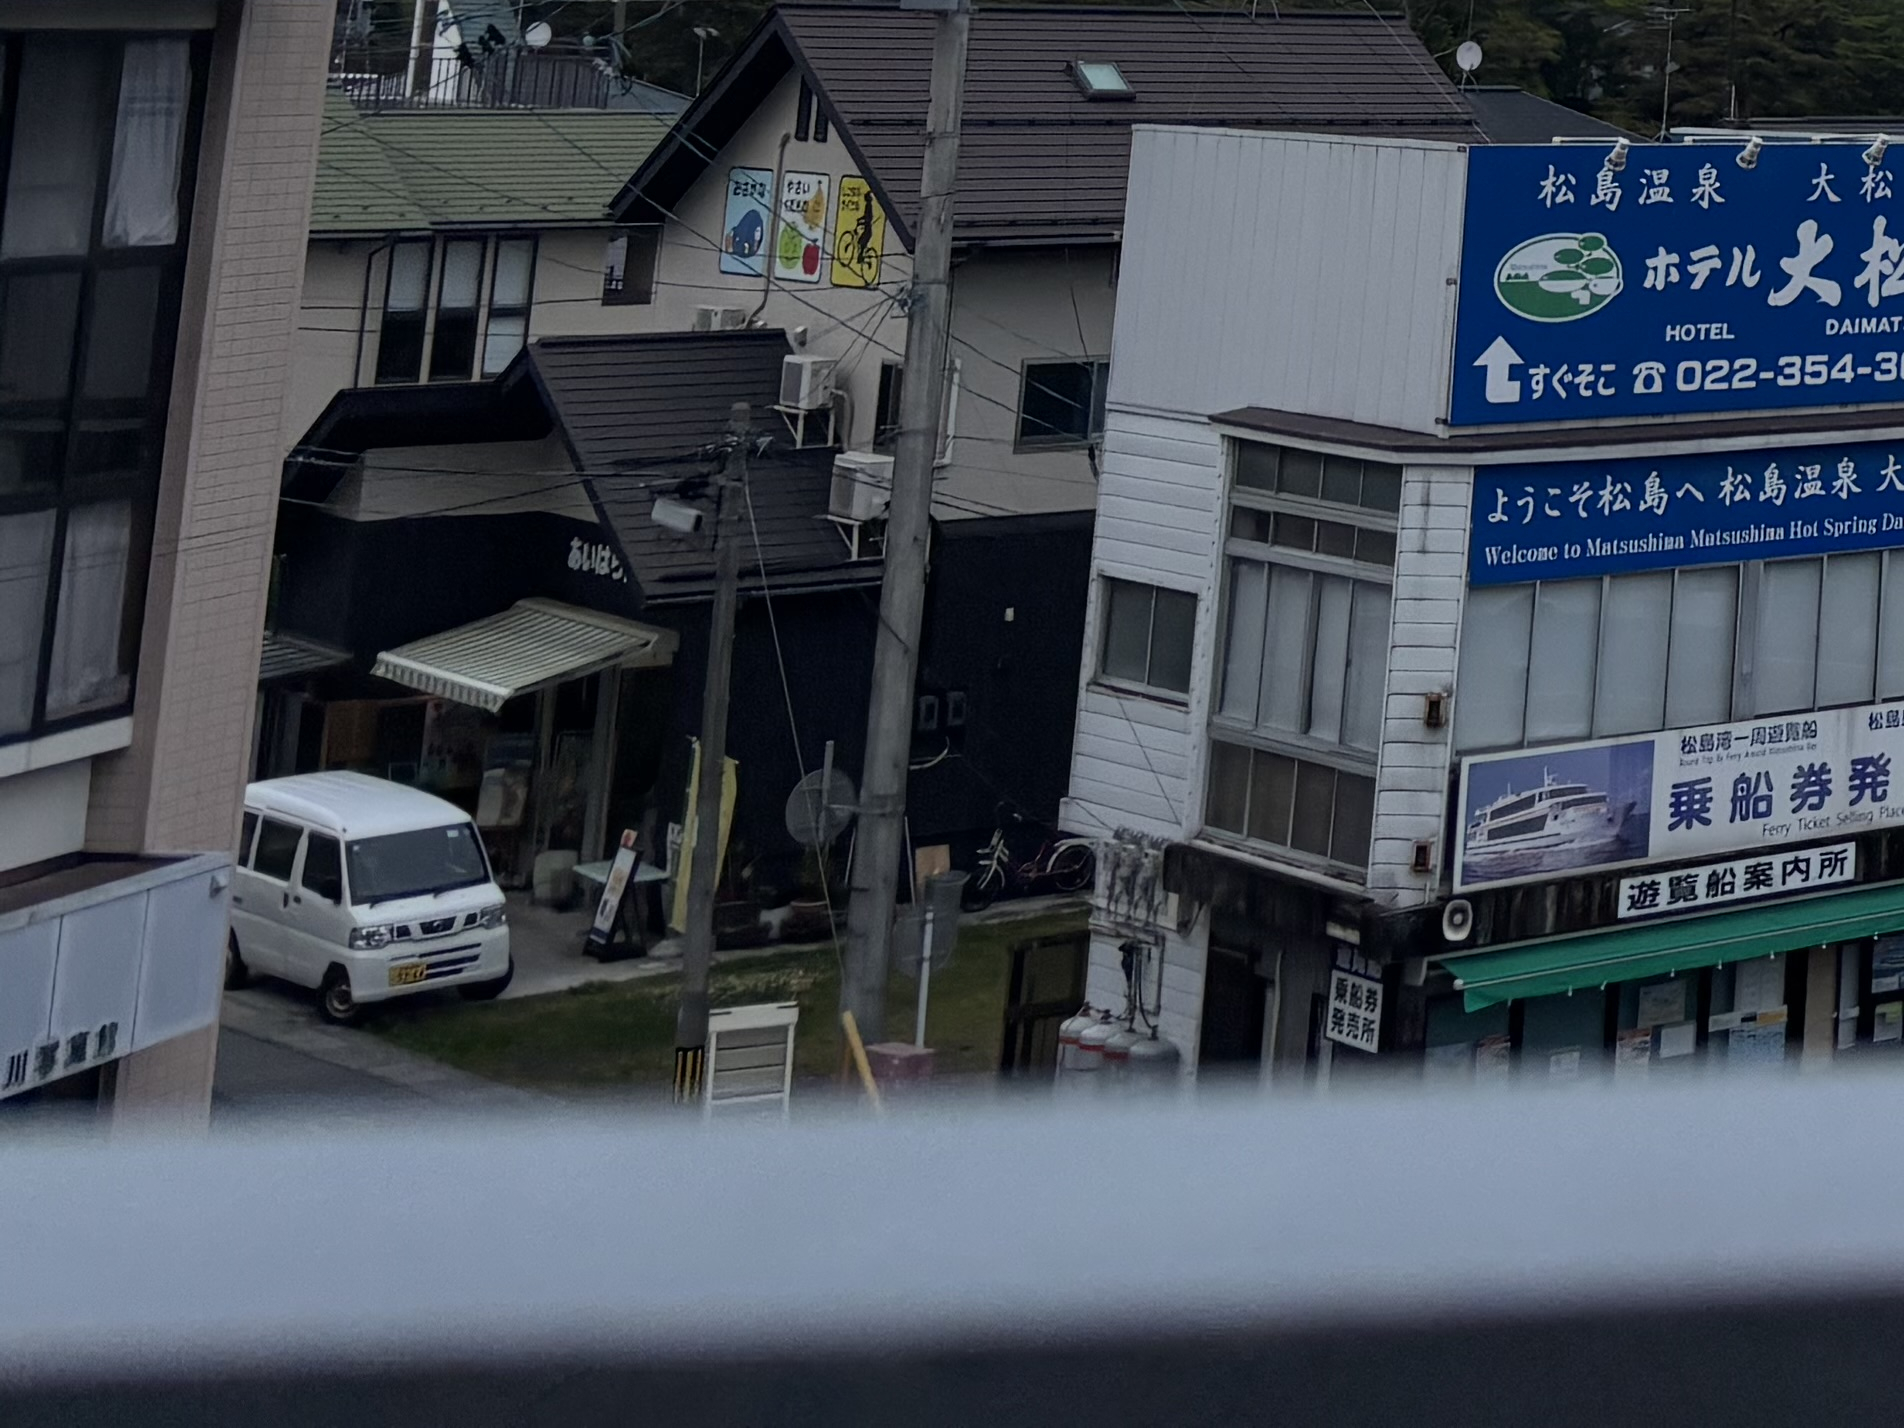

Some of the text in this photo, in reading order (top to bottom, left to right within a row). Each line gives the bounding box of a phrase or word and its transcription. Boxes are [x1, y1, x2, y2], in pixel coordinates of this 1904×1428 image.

[1538, 163, 1725, 211] 松島温泉
[1665, 323, 1735, 341] HOTEL
[1528, 362, 1616, 401] すぐそこ
[1487, 470, 1705, 525] ようこそ松島へ
[1718, 456, 1862, 507] 松島温泉
[1485, 542, 1558, 567] Welcome
[1564, 541, 1581, 558] to
[1586, 532, 1684, 557] Matsushima
[1789, 519, 1818, 539] Hot
[1823, 513, 1877, 540] Spring
[1762, 822, 1792, 838] Ferry
[1626, 848, 1850, 912] 遊覧船案内所
[1335, 977, 1378, 1012] 乗船券
[1331, 1007, 1375, 1046] 発売所
